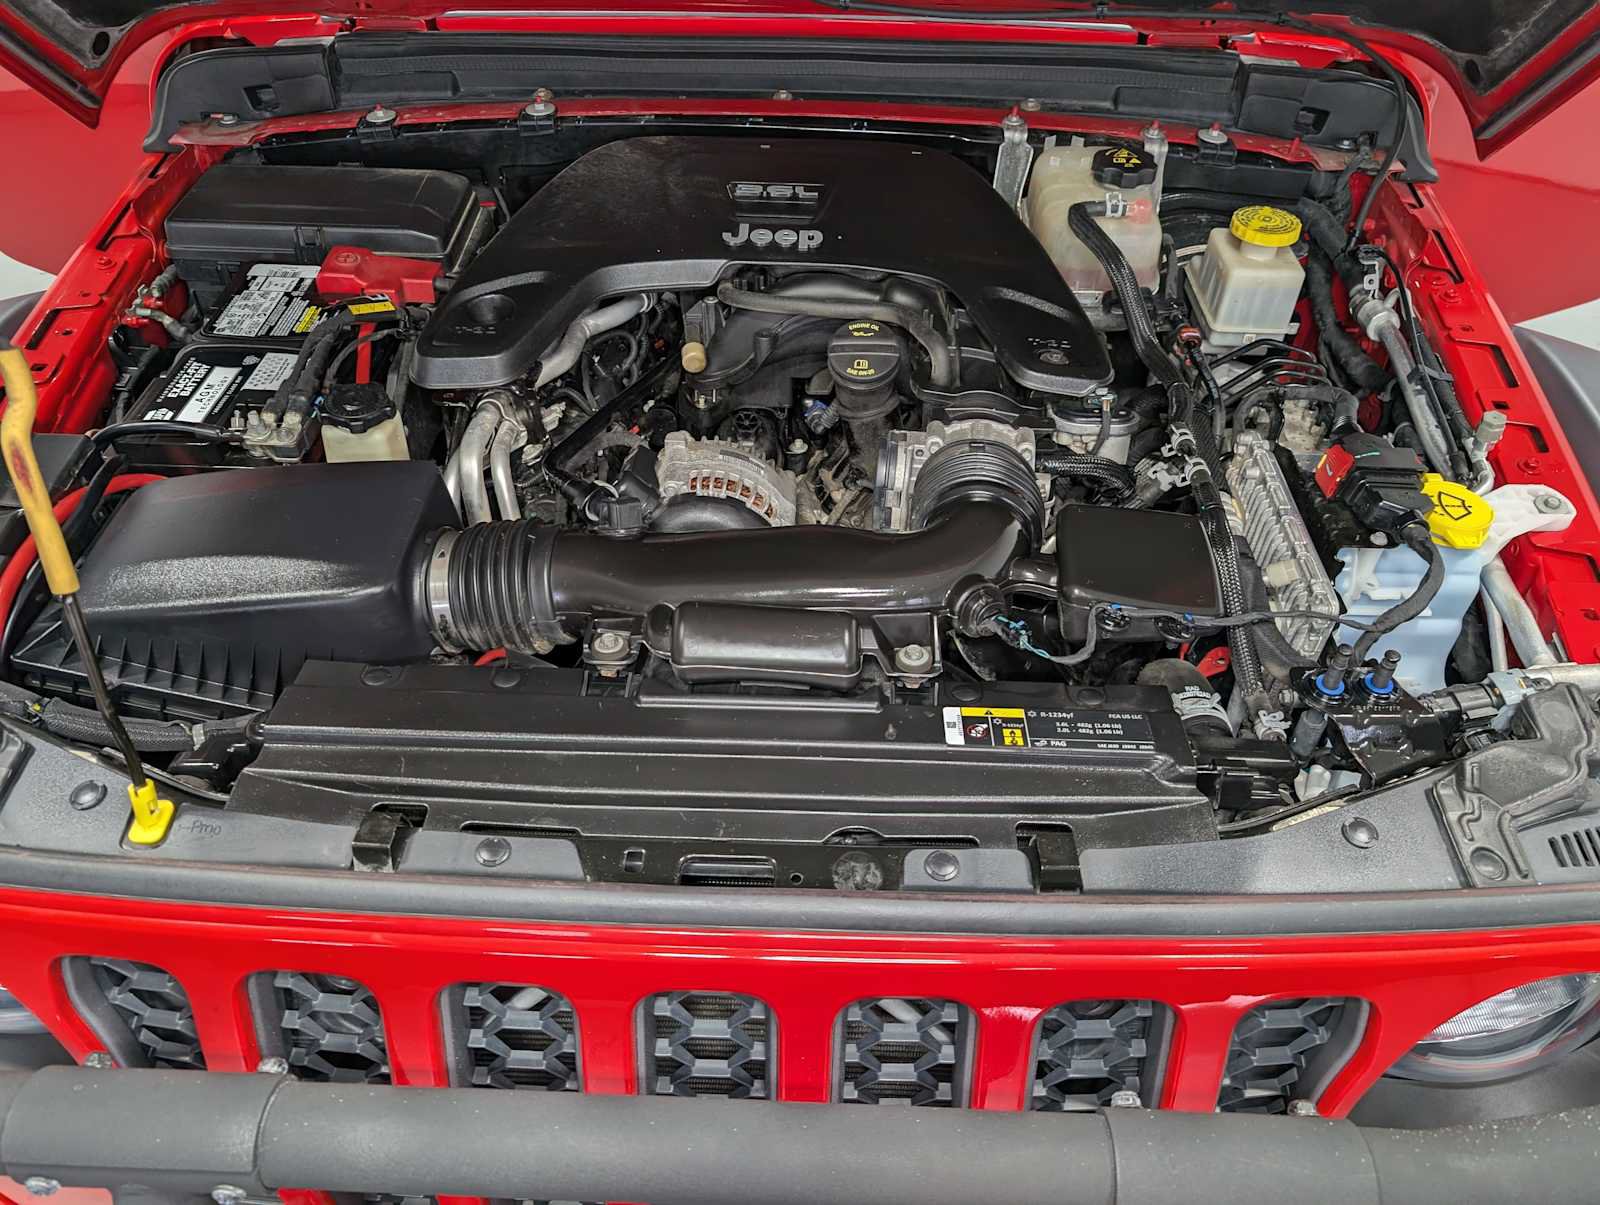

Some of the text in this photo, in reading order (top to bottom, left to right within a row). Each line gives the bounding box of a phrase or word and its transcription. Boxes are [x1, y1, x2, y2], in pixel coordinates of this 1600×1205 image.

[722, 223, 824, 252] Jeep
[166, 361, 202, 398] EXACT-FIT
[178, 364, 212, 397] BATTERY
[194, 382, 215, 403] AGM
[197, 375, 229, 413] TECHNOLOGY
[1040, 711, 1074, 719] R-1234yf
